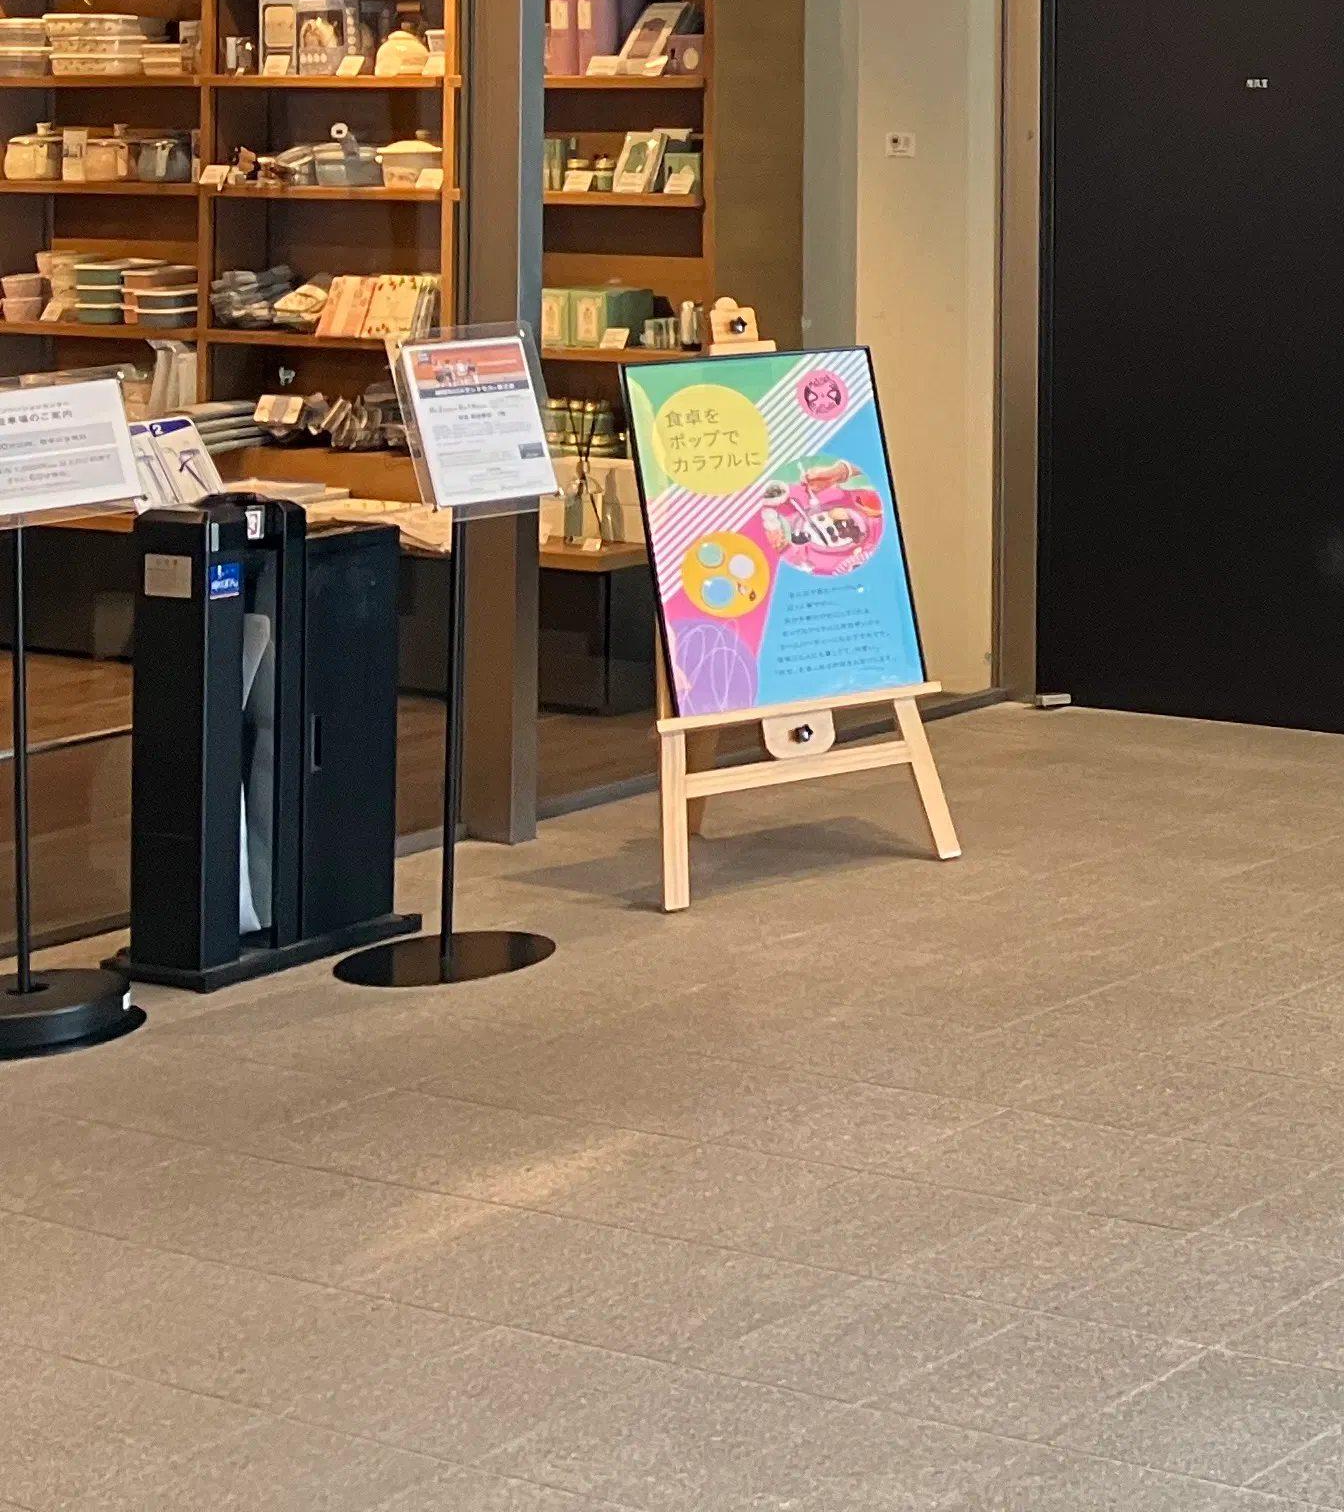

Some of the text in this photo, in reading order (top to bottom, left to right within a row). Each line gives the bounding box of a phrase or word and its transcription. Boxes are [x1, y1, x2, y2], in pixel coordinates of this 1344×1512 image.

[665, 408, 719, 428] 食卓を
[151, 423, 163, 435] 2
[669, 429, 740, 450] ポップで
[673, 452, 762, 474] カラフルに
